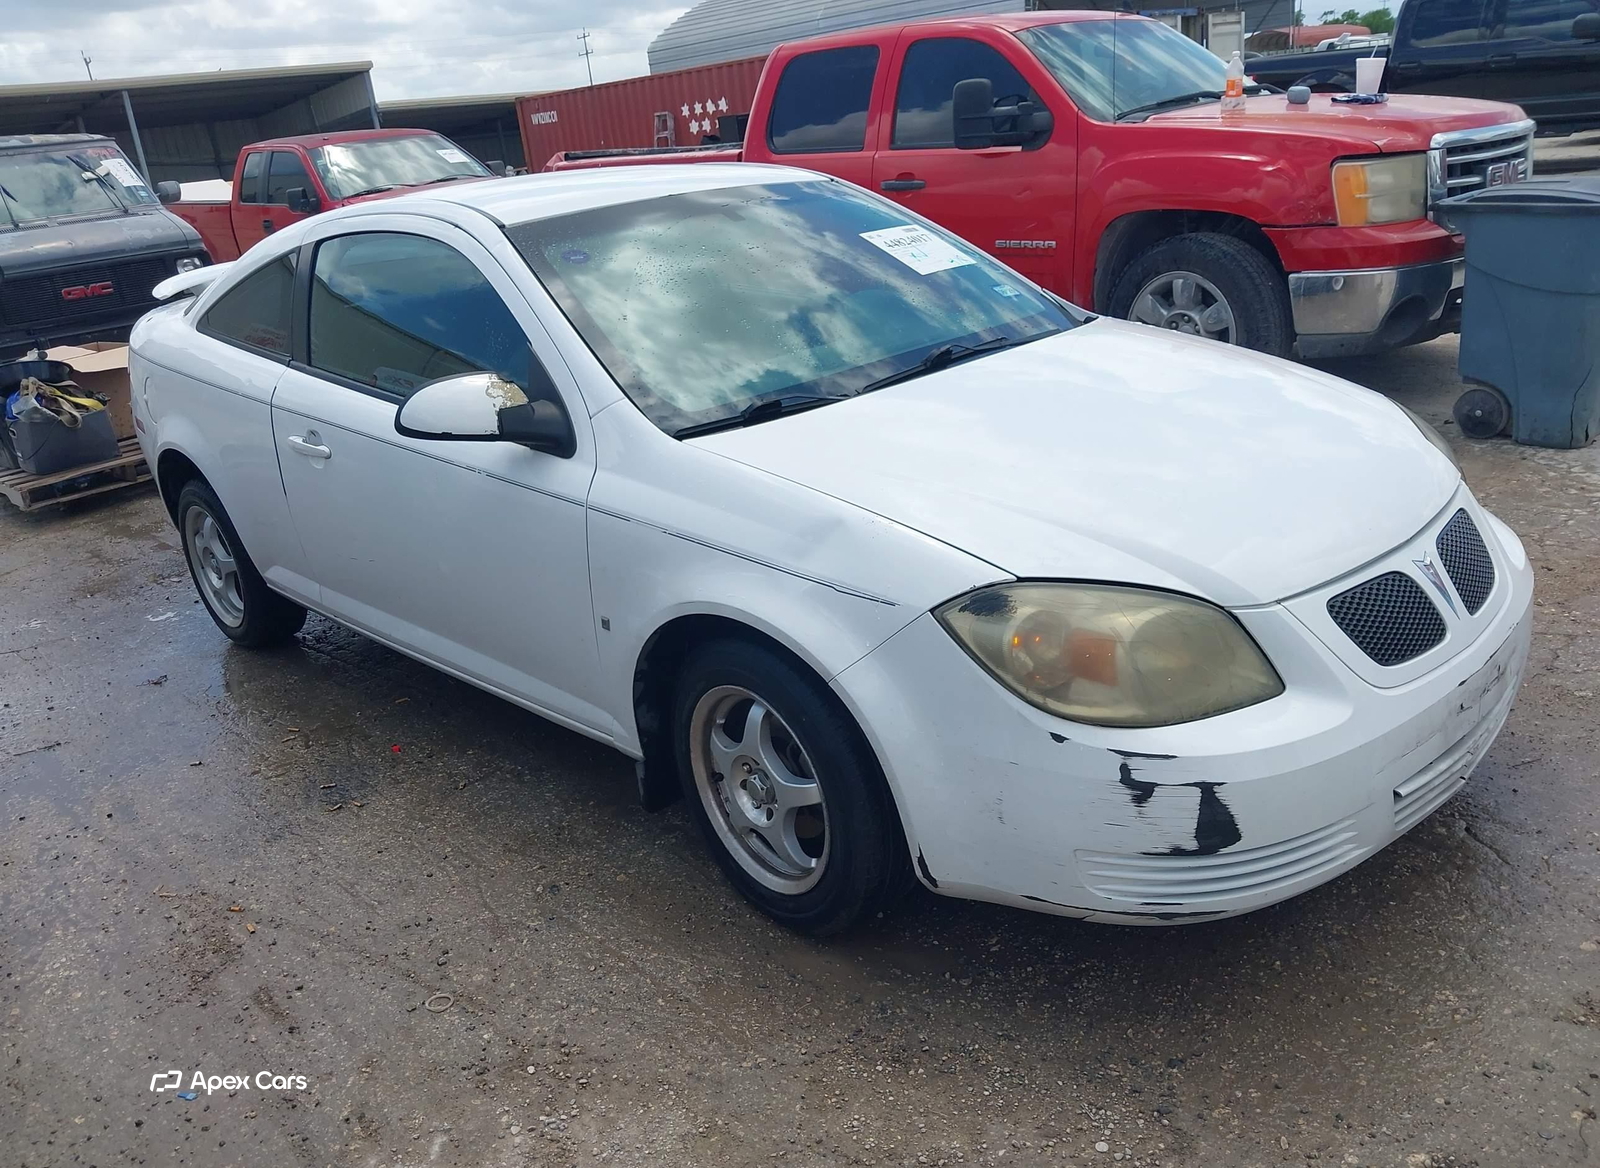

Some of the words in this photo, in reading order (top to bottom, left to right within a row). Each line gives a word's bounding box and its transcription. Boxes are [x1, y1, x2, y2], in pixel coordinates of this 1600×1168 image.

[1487, 157, 1526, 188] GMC
[995, 240, 1057, 249] SIERRA
[61, 281, 114, 299] GMC
